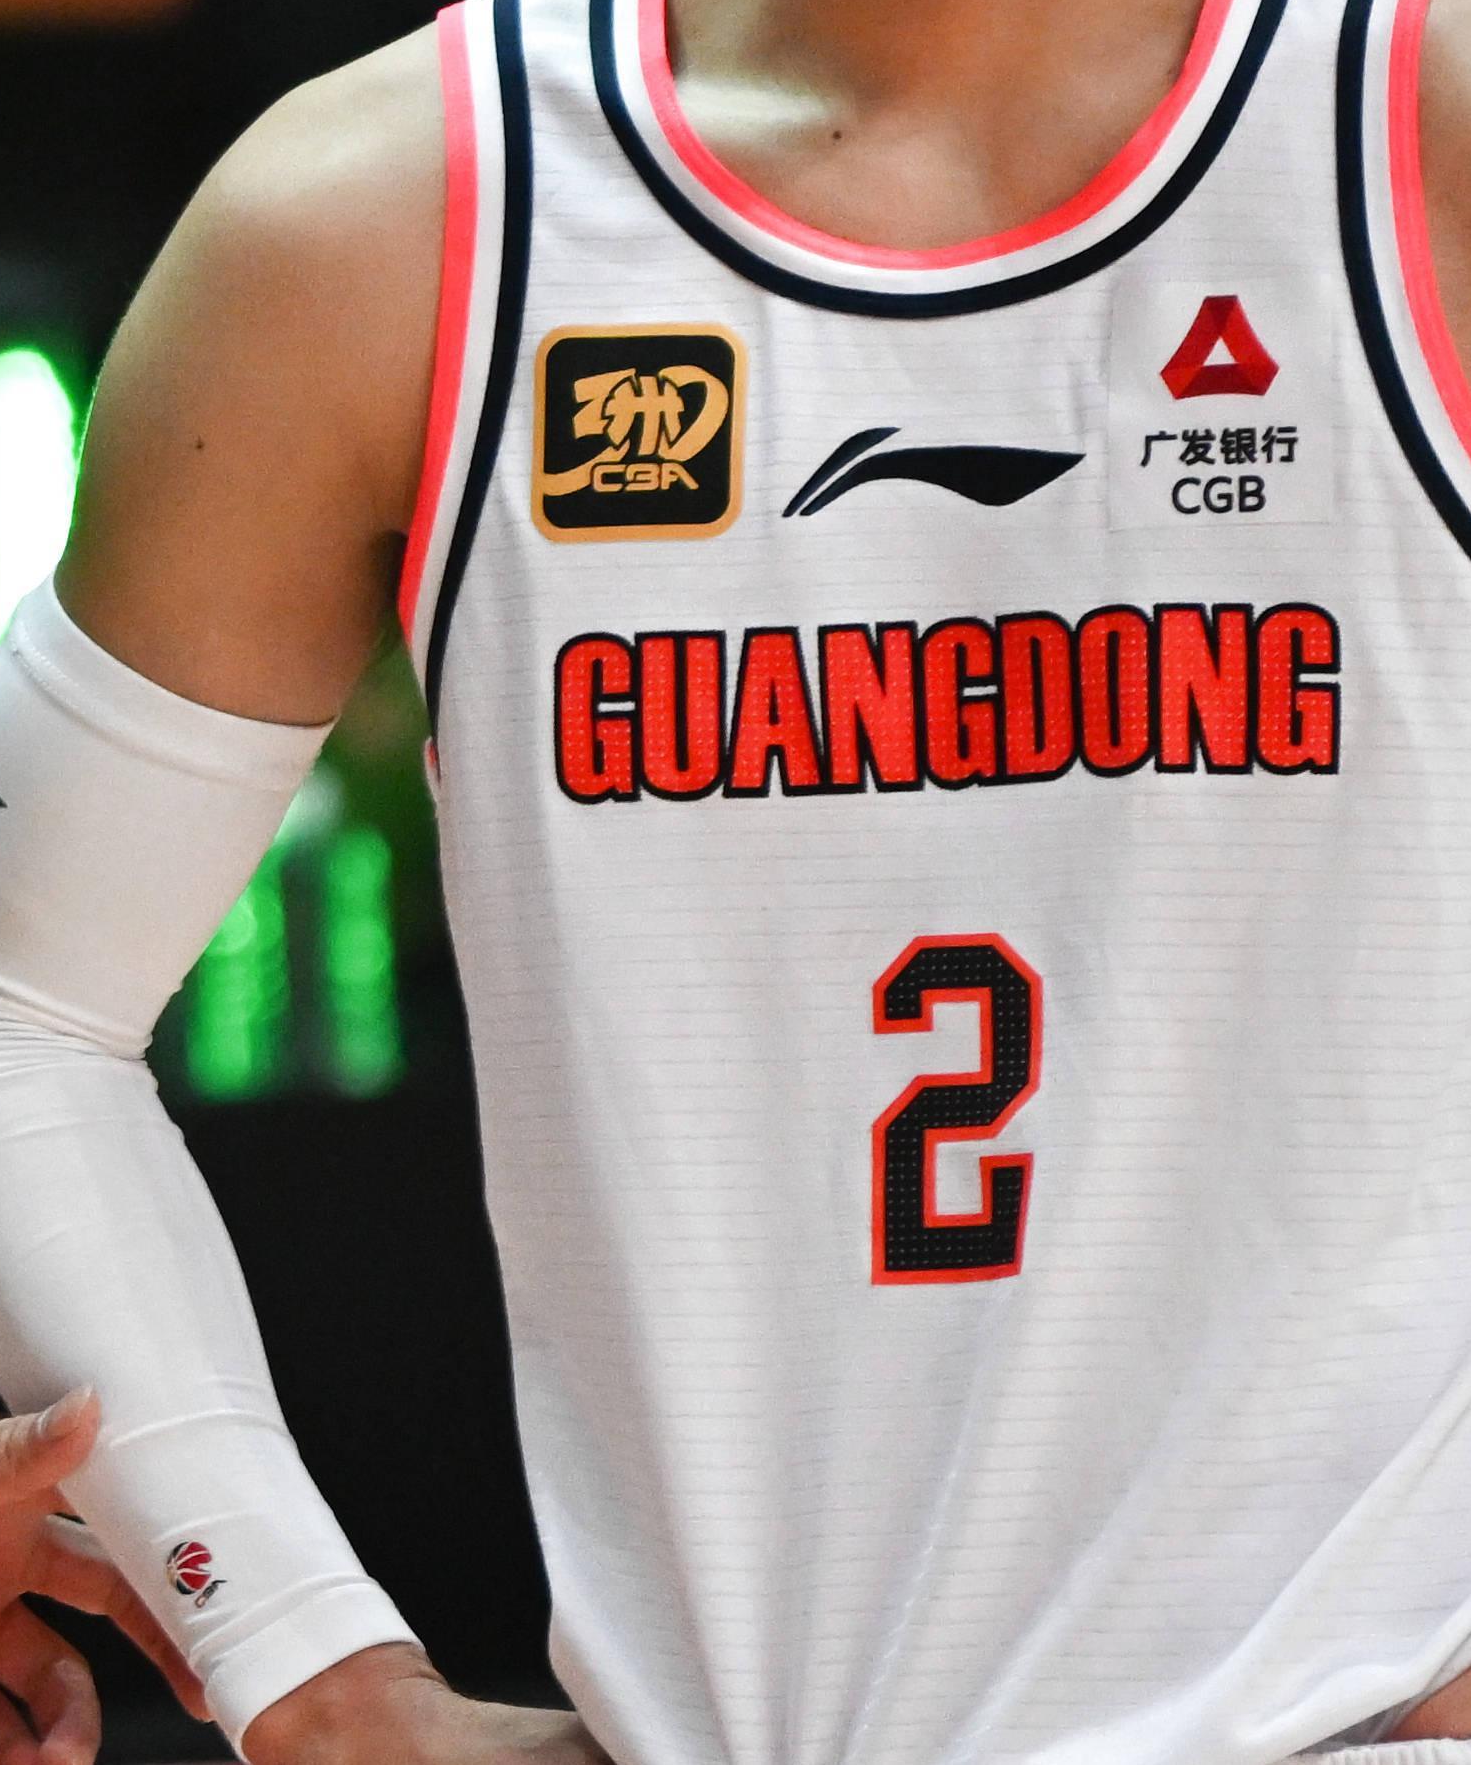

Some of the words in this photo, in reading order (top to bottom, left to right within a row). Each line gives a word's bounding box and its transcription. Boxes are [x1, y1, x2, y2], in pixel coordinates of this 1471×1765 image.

[1140, 425, 1298, 467] 广发银行
[592, 462, 700, 495] CBA
[1172, 475, 1266, 515] CGB
[554, 603, 1340, 804] GUANGDONG
[871, 933, 1043, 1286] 2
